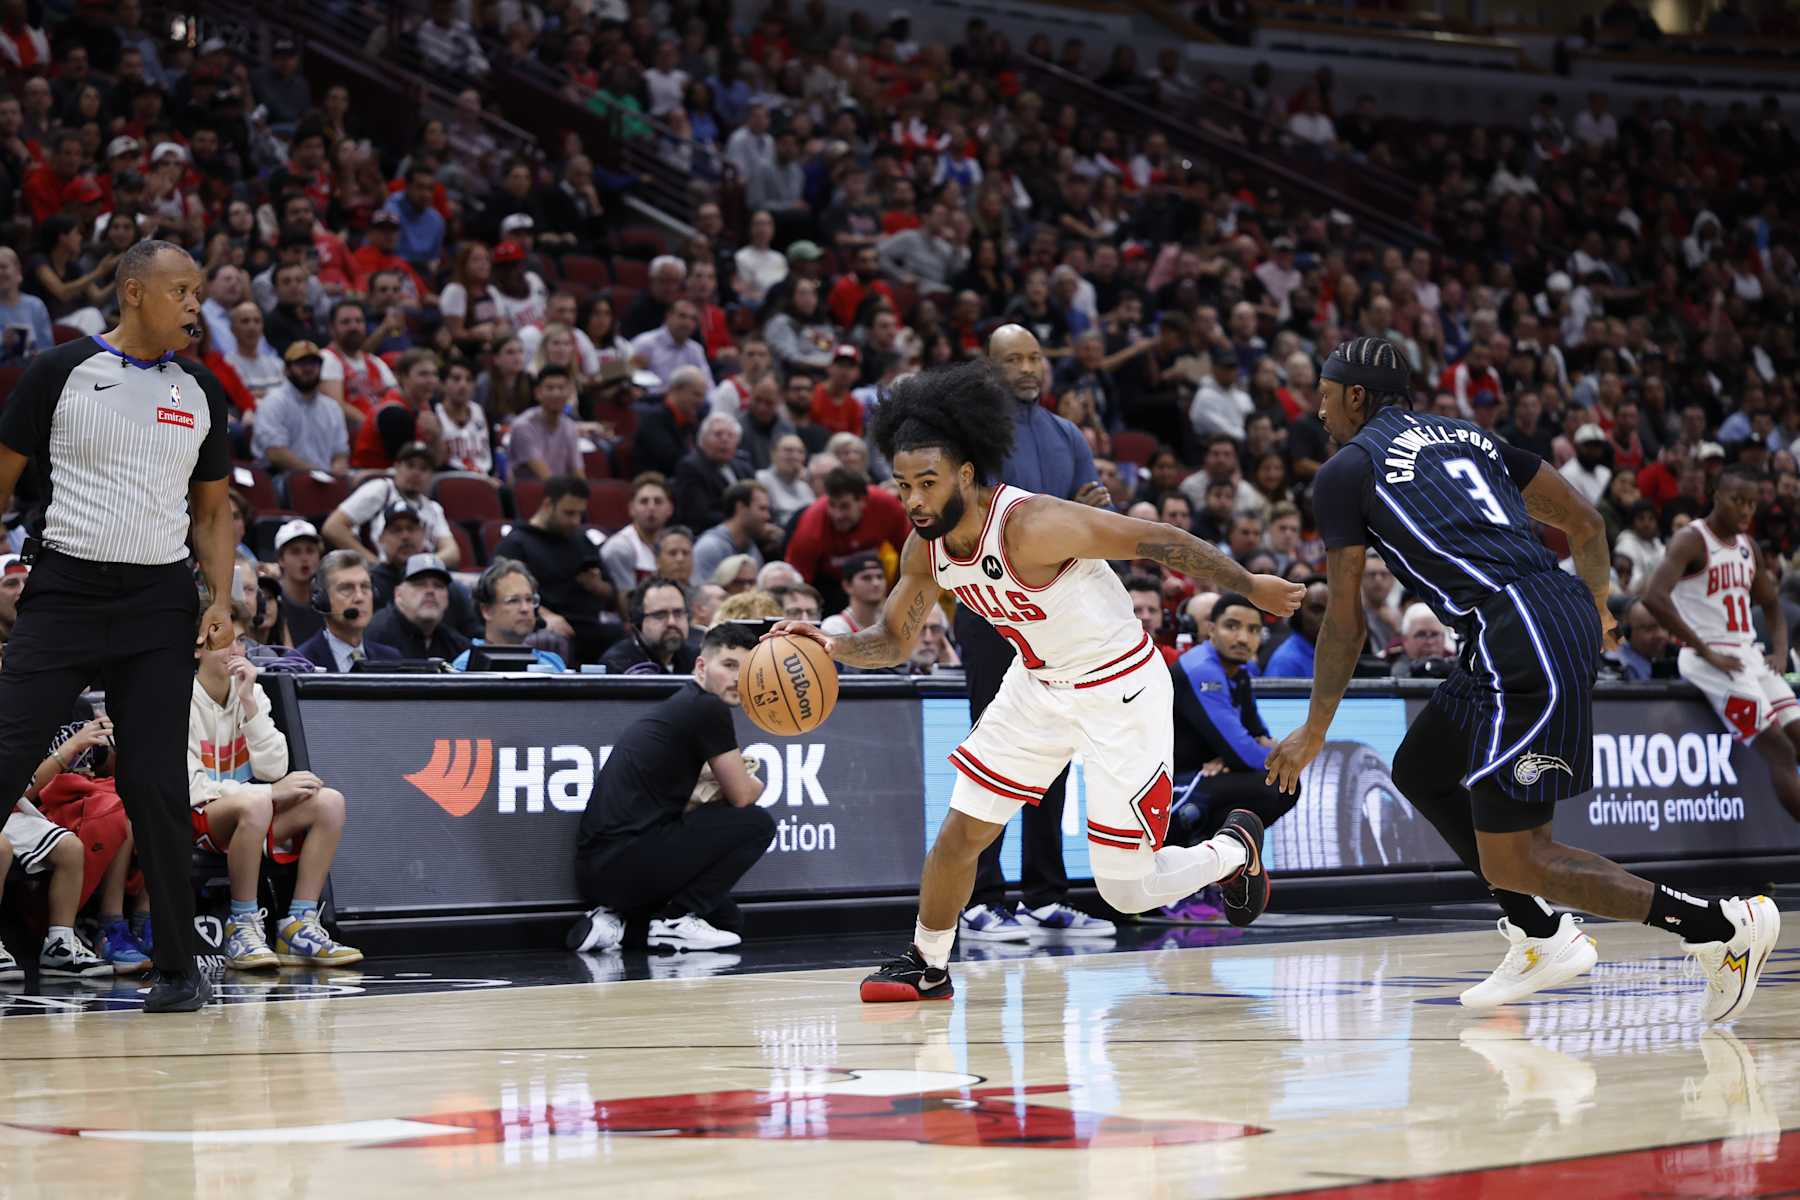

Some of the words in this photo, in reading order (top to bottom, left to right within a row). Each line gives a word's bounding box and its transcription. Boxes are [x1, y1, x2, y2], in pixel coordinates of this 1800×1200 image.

[158, 410, 195, 426] Emirates
[1442, 457, 1511, 526] 3
[953, 583, 1047, 622] ULLS
[1723, 594, 1750, 632] 11
[784, 652, 812, 721] Wilson
[1588, 793, 1660, 831] driving
[1663, 791, 1744, 823] emotion
[766, 814, 836, 853] tion
[193, 954, 226, 969] AND
